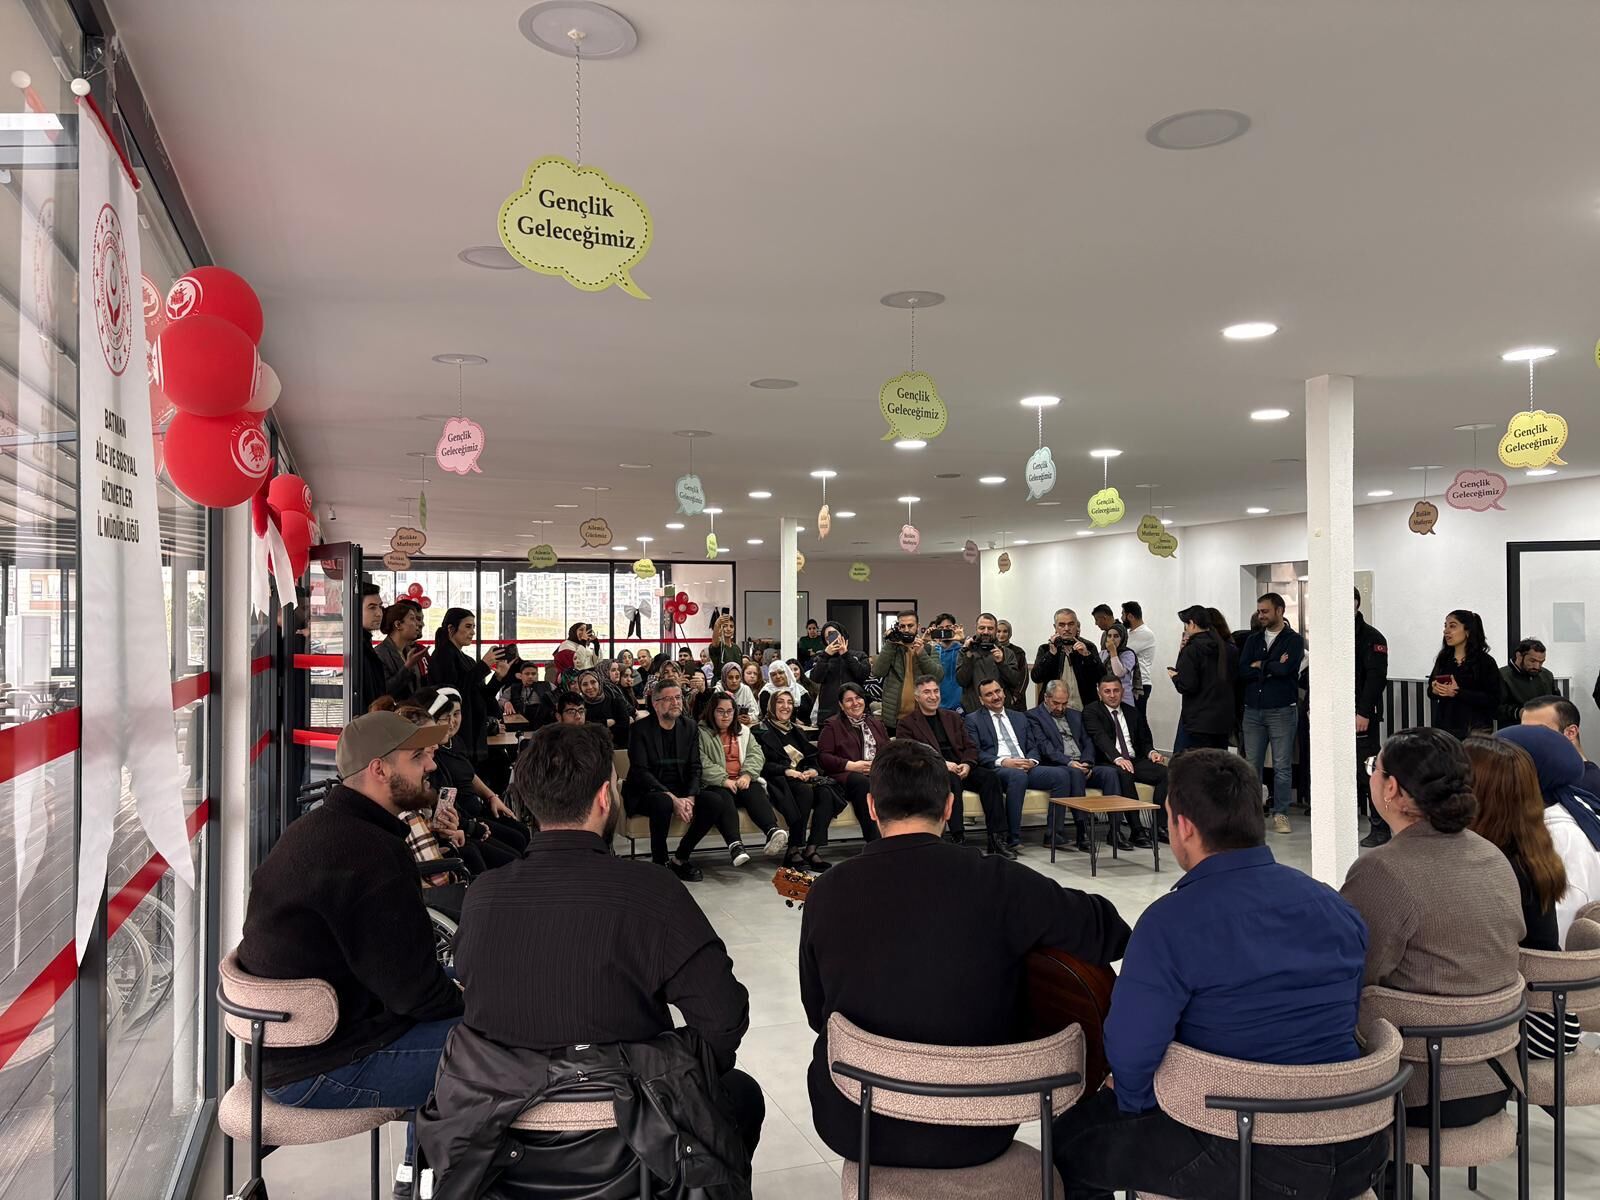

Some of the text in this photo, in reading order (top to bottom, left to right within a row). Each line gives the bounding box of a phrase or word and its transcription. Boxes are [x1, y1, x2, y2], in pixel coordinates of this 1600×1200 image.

[538, 189, 615, 219] Gençlik
[517, 215, 636, 250] Geleceğimiz
[896, 387, 930, 403] Gençlik
[887, 402, 940, 420] Geleceğimiz
[104, 408, 127, 439] BATMAN
[1513, 423, 1548, 438] Gençlik
[447, 430, 472, 443] Gençlik
[1505, 435, 1559, 453] Geleceğimiz
[96, 435, 138, 477] AİLE VE SOSYAL
[441, 442, 479, 457] Geleceğimiz
[101, 475, 133, 509] HİZMETLER
[1459, 479, 1491, 489] Gençlik
[1096, 498, 1115, 506] Gençlik
[1452, 488, 1500, 499] Geleceğimiz
[97, 509, 140, 543] İL MÜDÜRLÜĞÜ
